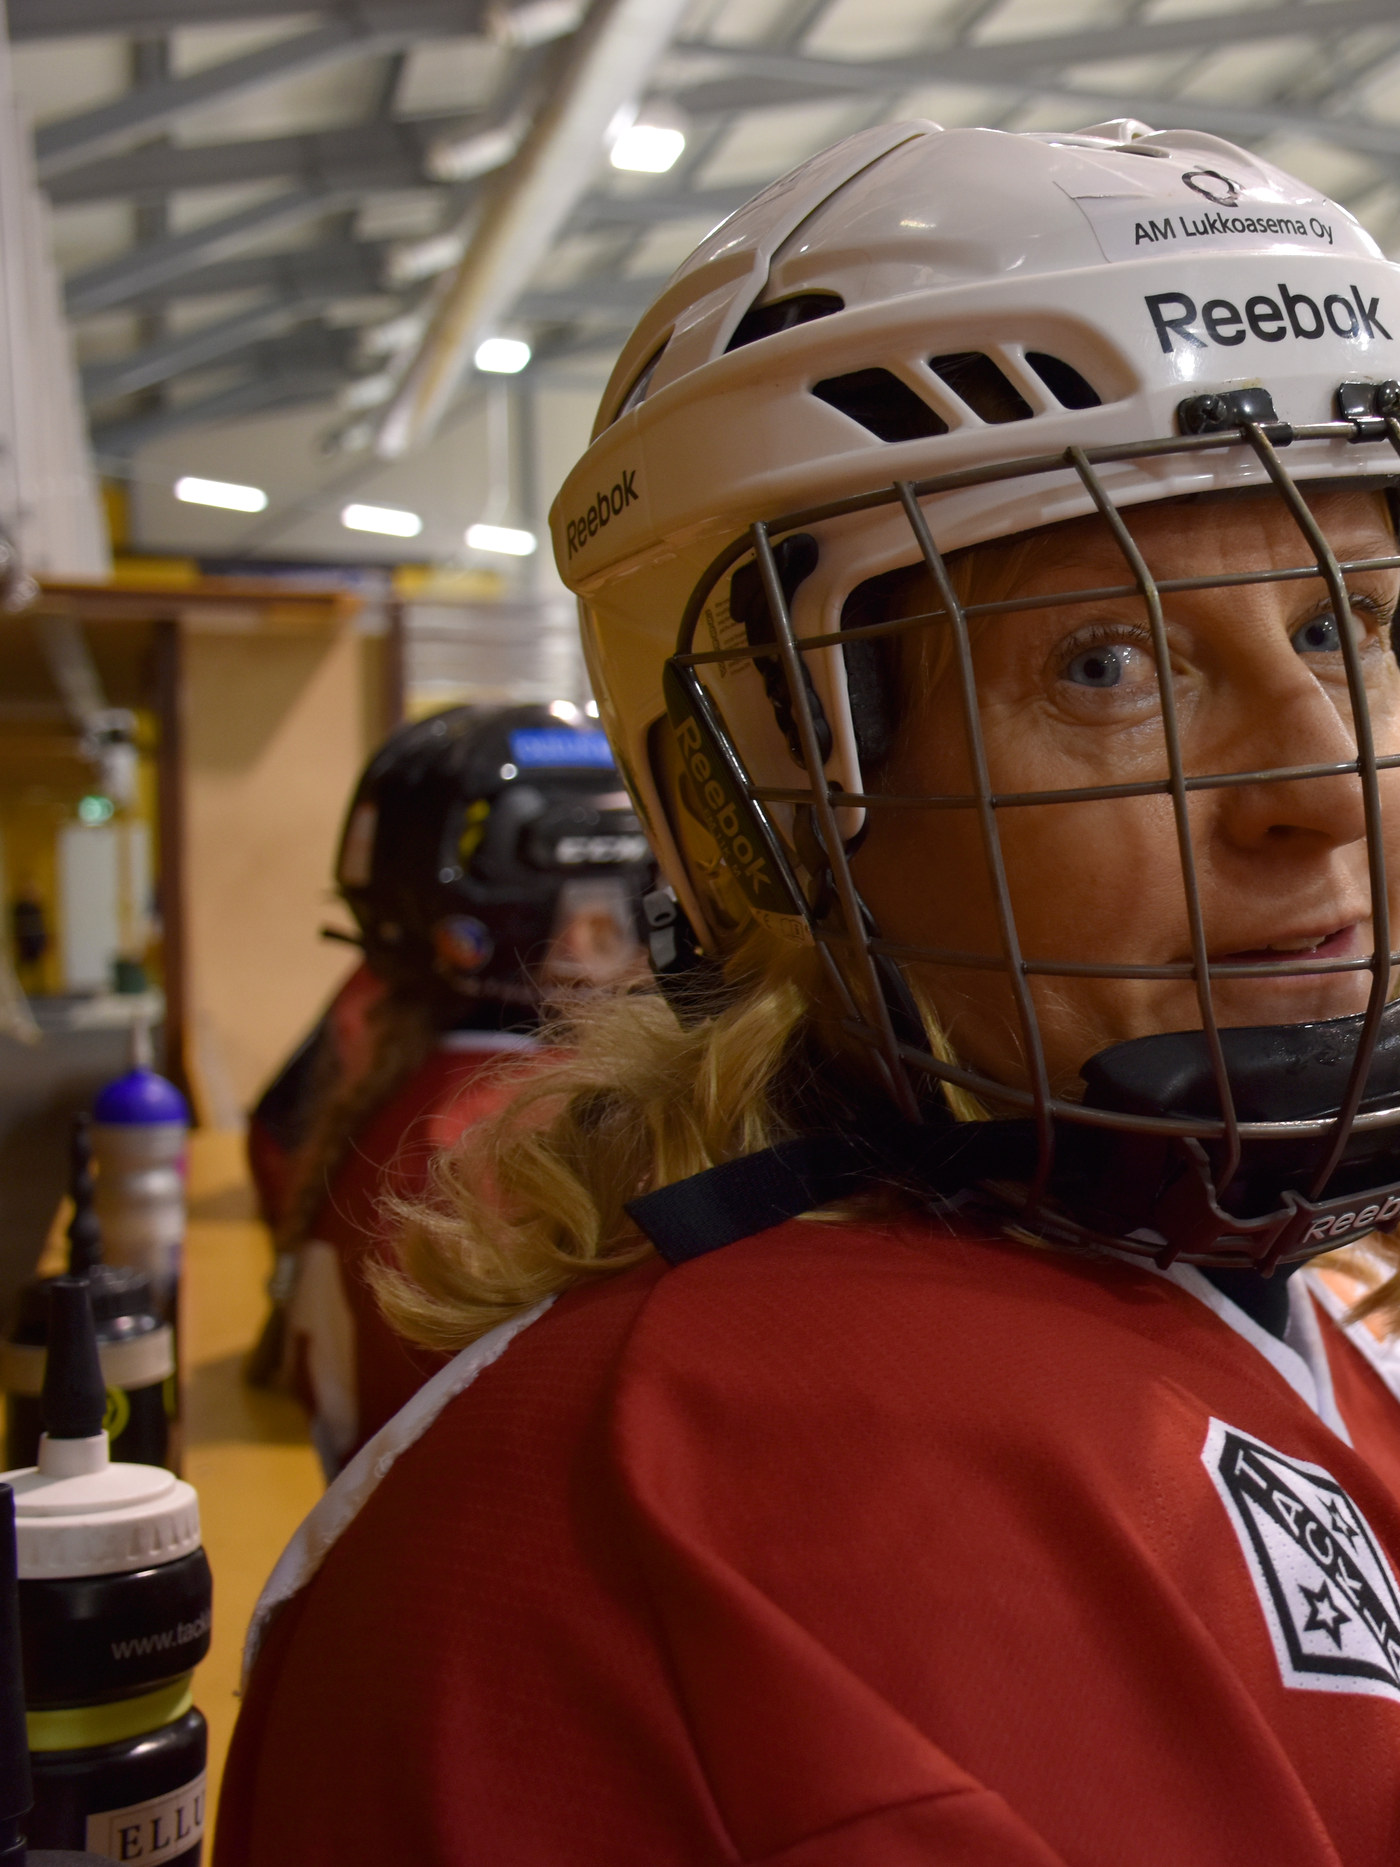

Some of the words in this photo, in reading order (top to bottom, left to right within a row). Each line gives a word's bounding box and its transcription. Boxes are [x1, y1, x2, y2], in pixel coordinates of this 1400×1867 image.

[1135, 217, 1176, 245] AM
[1179, 213, 1307, 237] Lukkoasema
[1310, 217, 1333, 245] Oy
[1144, 283, 1393, 354] Reebok
[566, 469, 639, 560] Reebok
[674, 716, 771, 894] Reebok
